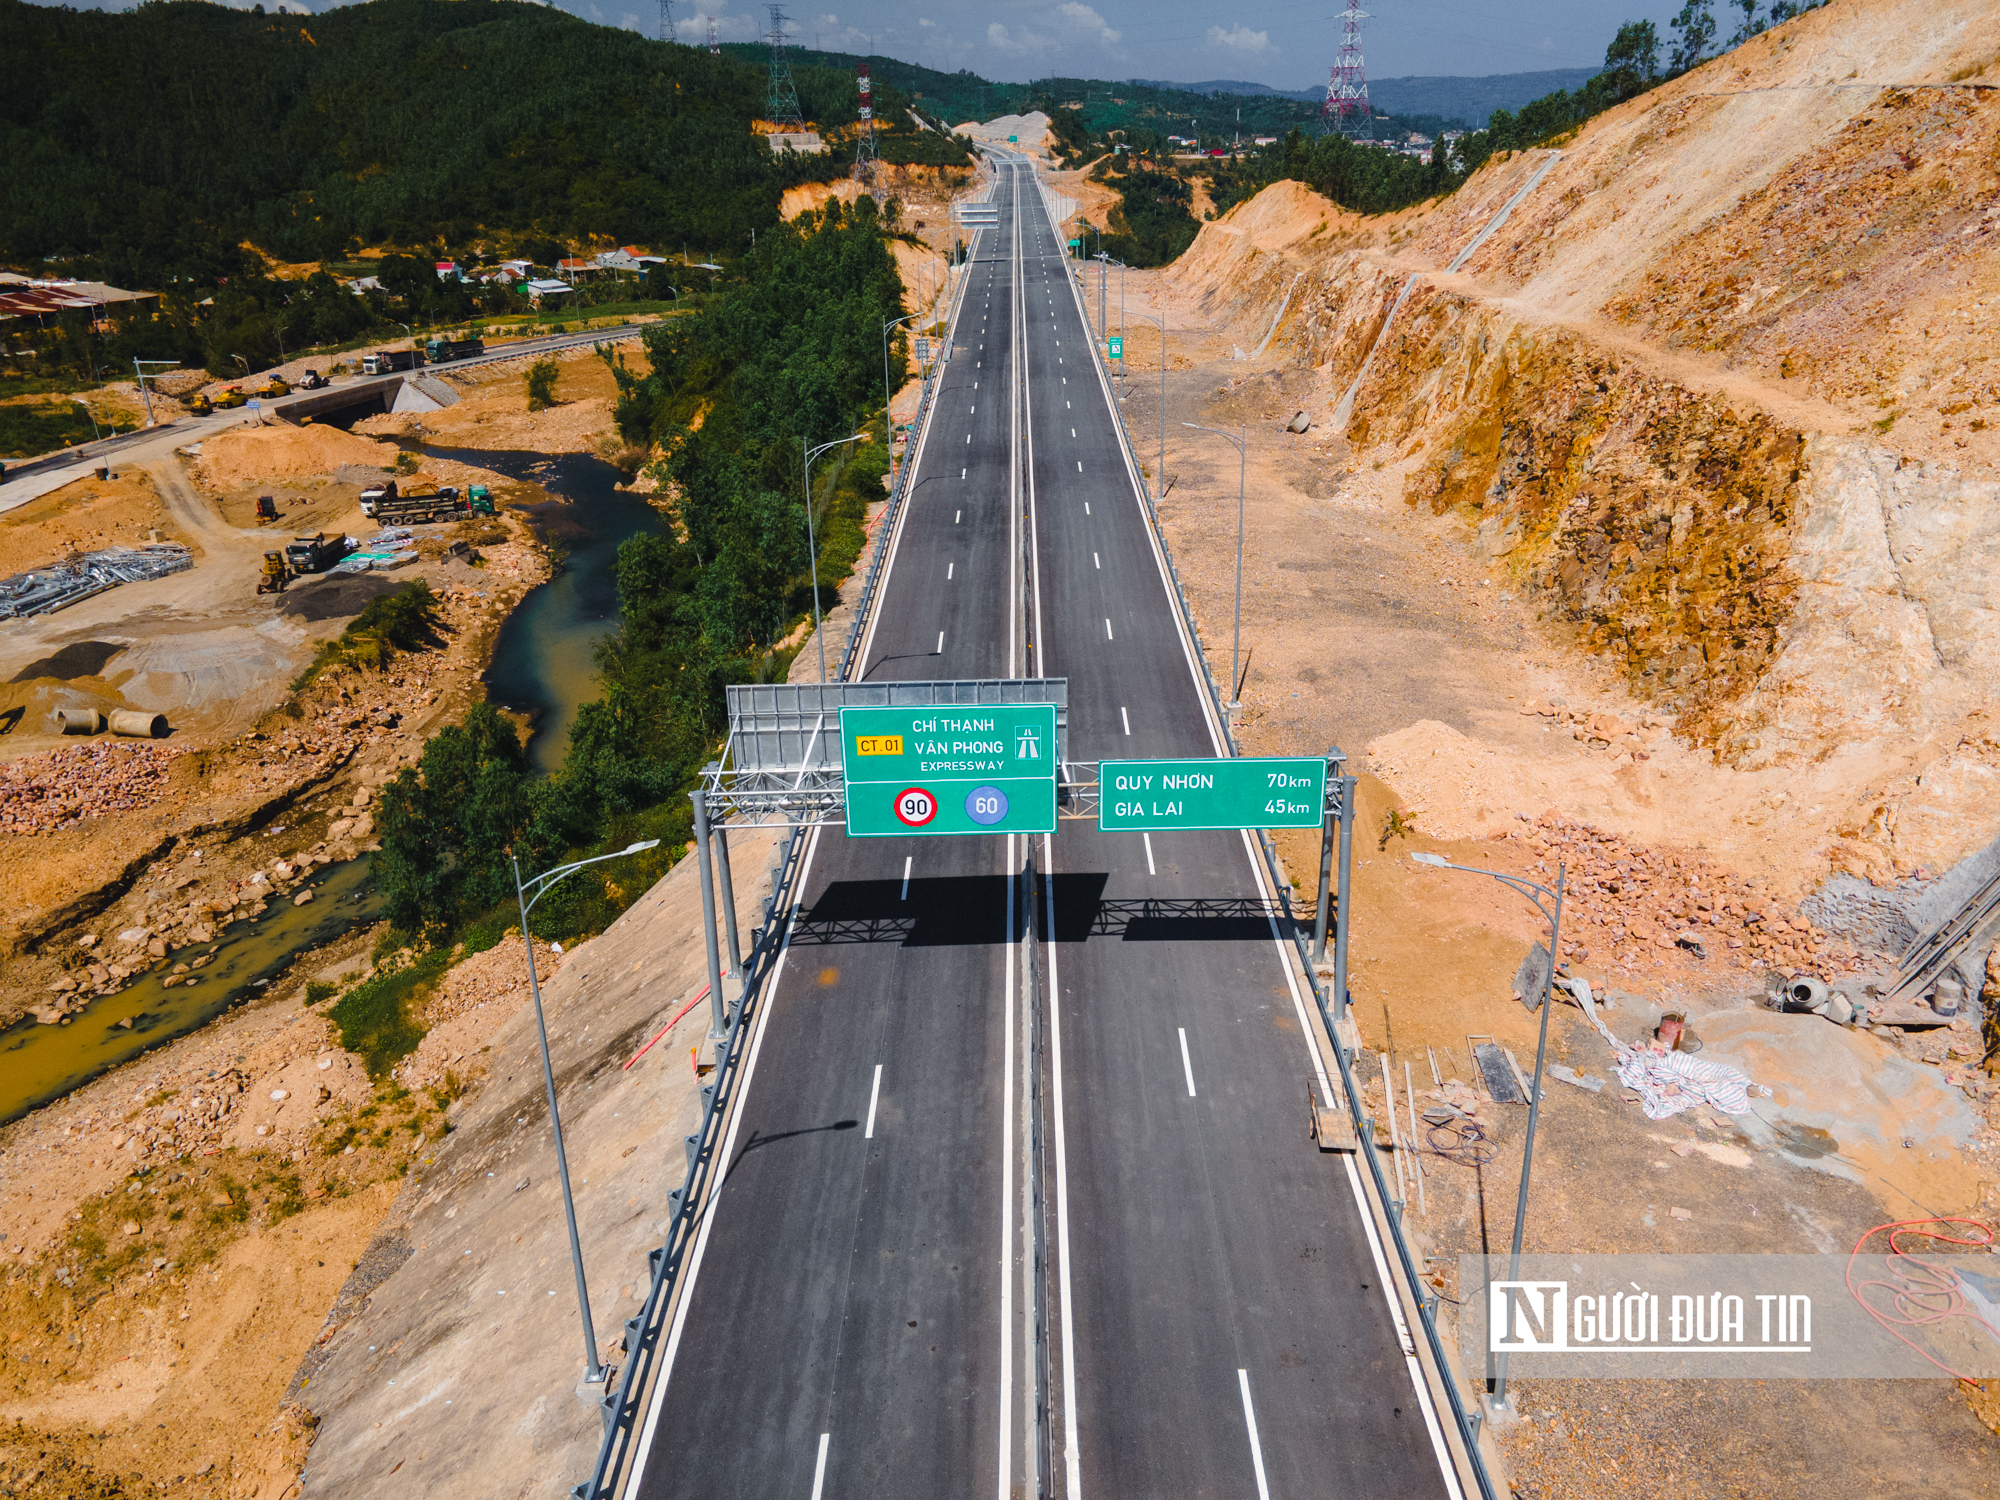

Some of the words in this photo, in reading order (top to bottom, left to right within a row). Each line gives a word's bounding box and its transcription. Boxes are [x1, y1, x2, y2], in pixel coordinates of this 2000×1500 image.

[912, 716, 938, 733] CHÍ
[941, 718, 995, 734] THẠNH
[914, 739, 949, 755] VÂN
[953, 740, 1004, 755] PHONG
[920, 760, 1005, 772] EXPRESSWAY
[1115, 775, 1154, 790] QUY
[1162, 772, 1214, 790] NHƠN
[905, 799, 928, 815] 90
[975, 797, 998, 815] 60
[1114, 801, 1145, 817] GIA
[1152, 800, 1183, 816] LAI
